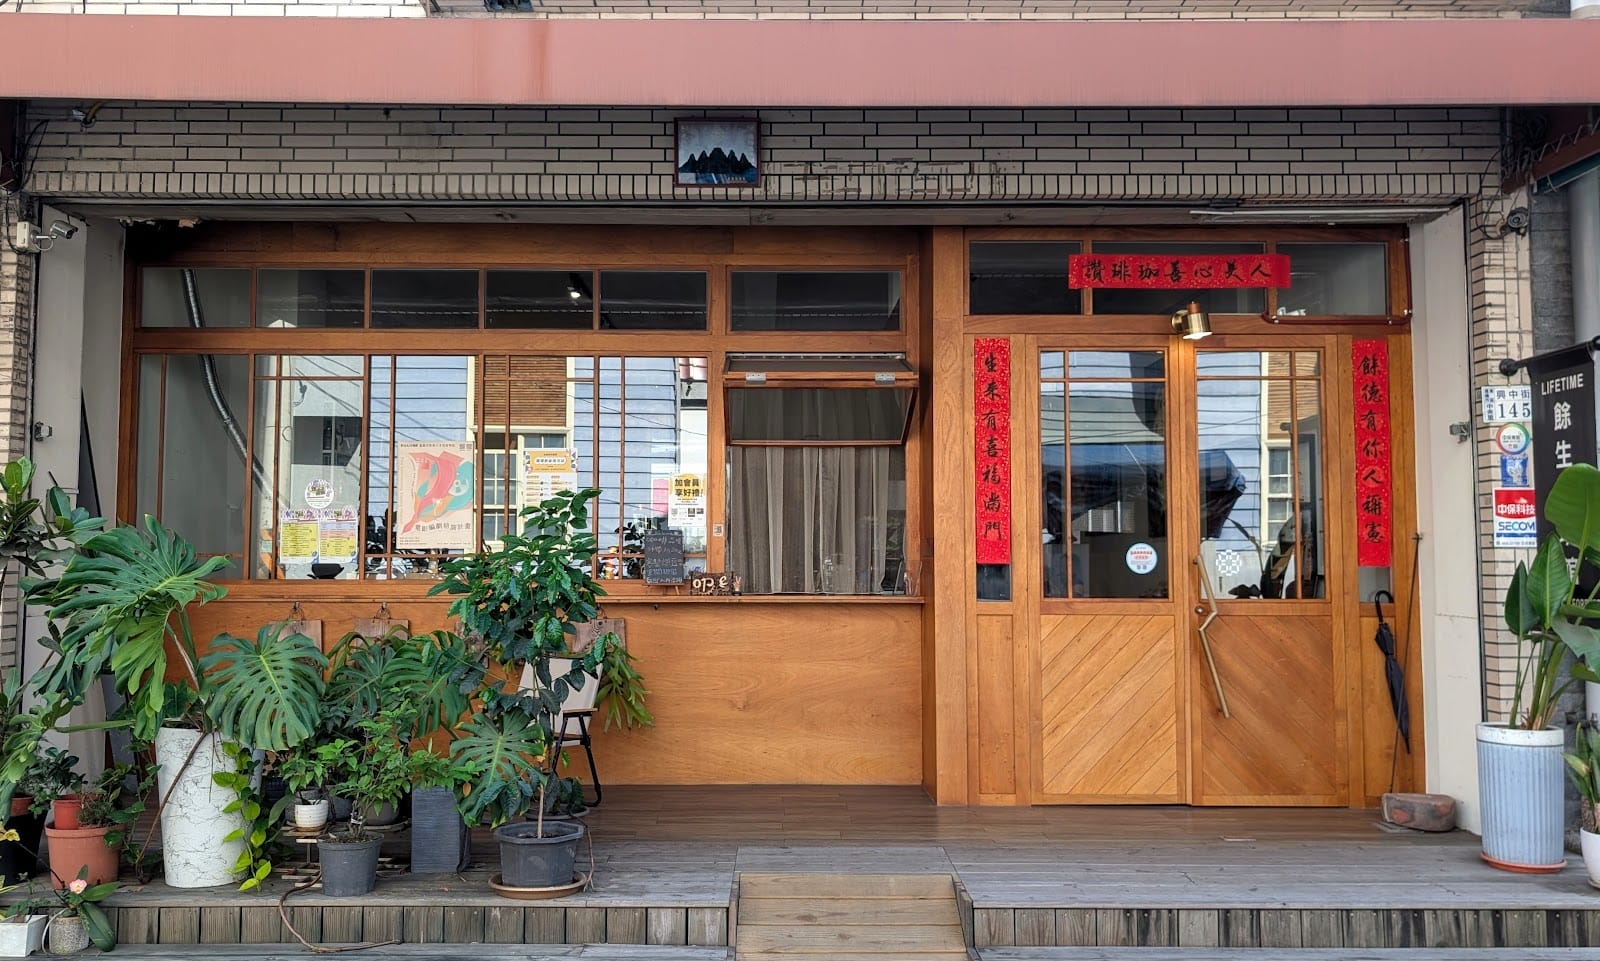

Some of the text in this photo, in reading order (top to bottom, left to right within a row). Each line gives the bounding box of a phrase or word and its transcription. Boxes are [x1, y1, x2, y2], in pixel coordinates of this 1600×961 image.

[1541, 373, 1584, 396] LIFETIME
[1496, 389, 1530, 400] 興中街
[1497, 402, 1531, 418] 145
[981, 352, 1003, 539] 生來有喜福滿門
[674, 478, 700, 487] 加會員
[1497, 503, 1536, 515] 中保科技
[1498, 521, 1536, 531] SECOM
